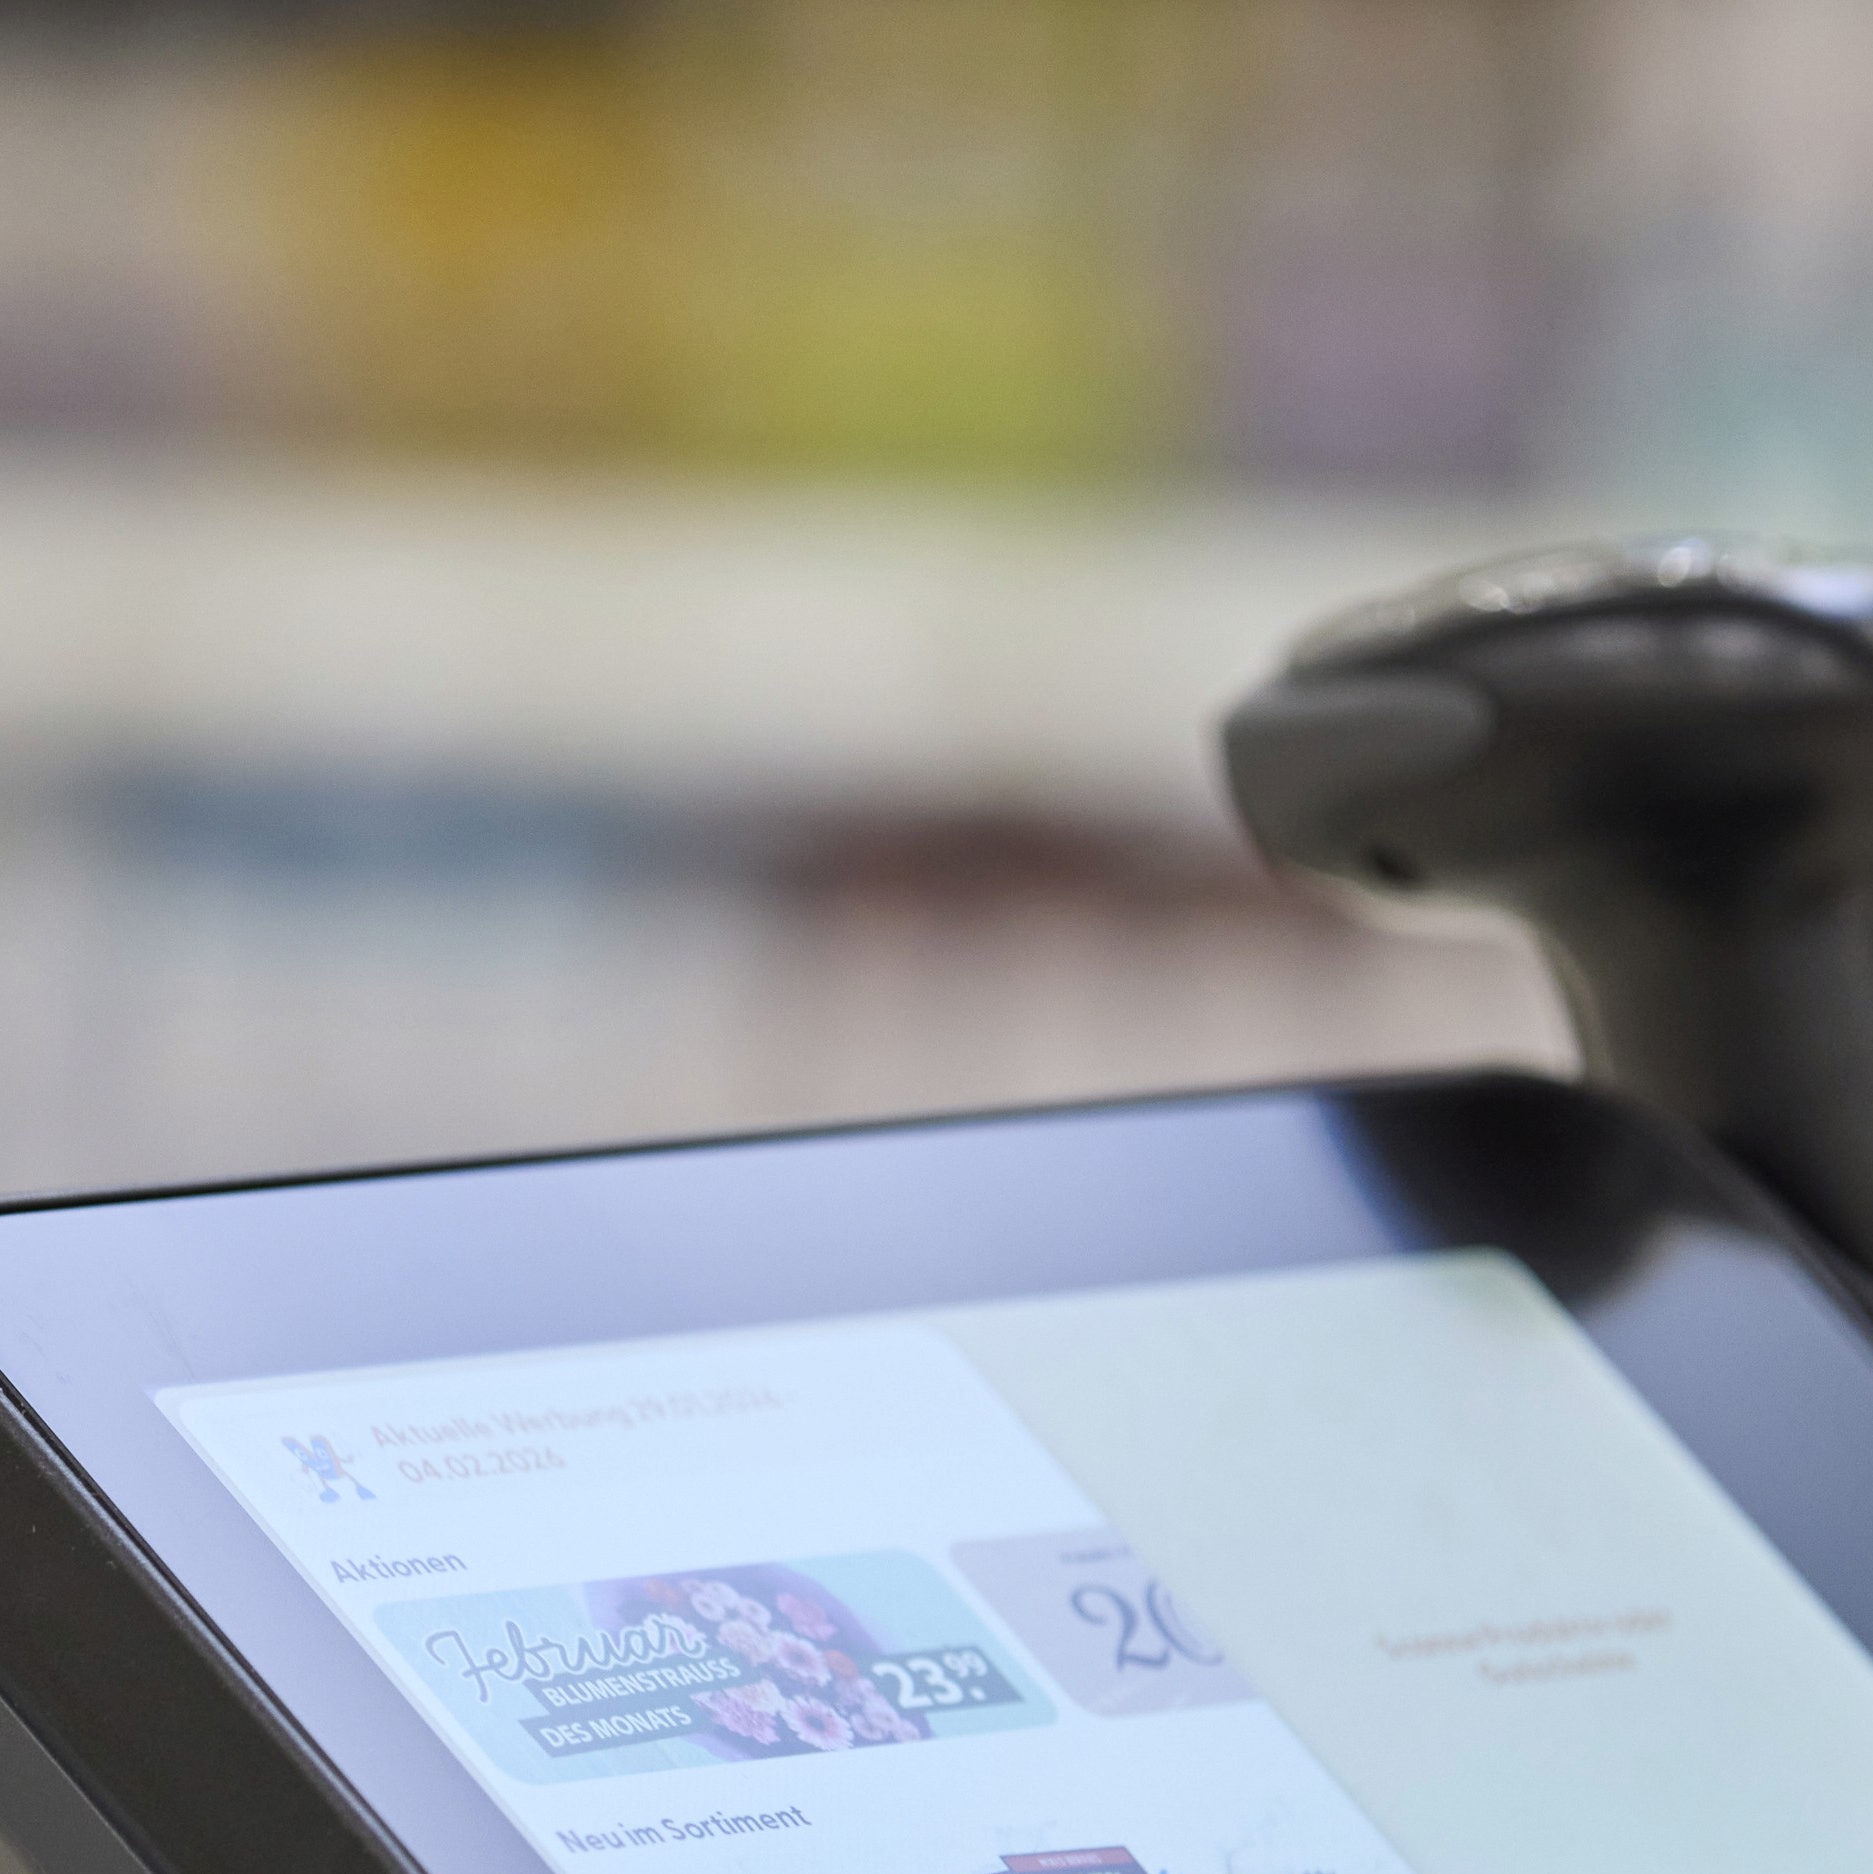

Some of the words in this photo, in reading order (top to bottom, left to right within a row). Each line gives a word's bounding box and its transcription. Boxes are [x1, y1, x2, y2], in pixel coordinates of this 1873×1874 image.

[371, 1413, 490, 1450] Aktuelle
[492, 1404, 636, 1436] Werbung
[397, 1446, 566, 1484] 04.02.2026
[330, 1549, 467, 1584] Aktionen
[425, 1614, 707, 1704] Februar
[542, 1657, 741, 1708] BLUMENSTRAUSS
[540, 1721, 592, 1748] DES
[595, 1705, 692, 1738] MONATS
[555, 1829, 625, 1853] Neu
[617, 1822, 666, 1846] im
[661, 1805, 813, 1841] Sortiment
